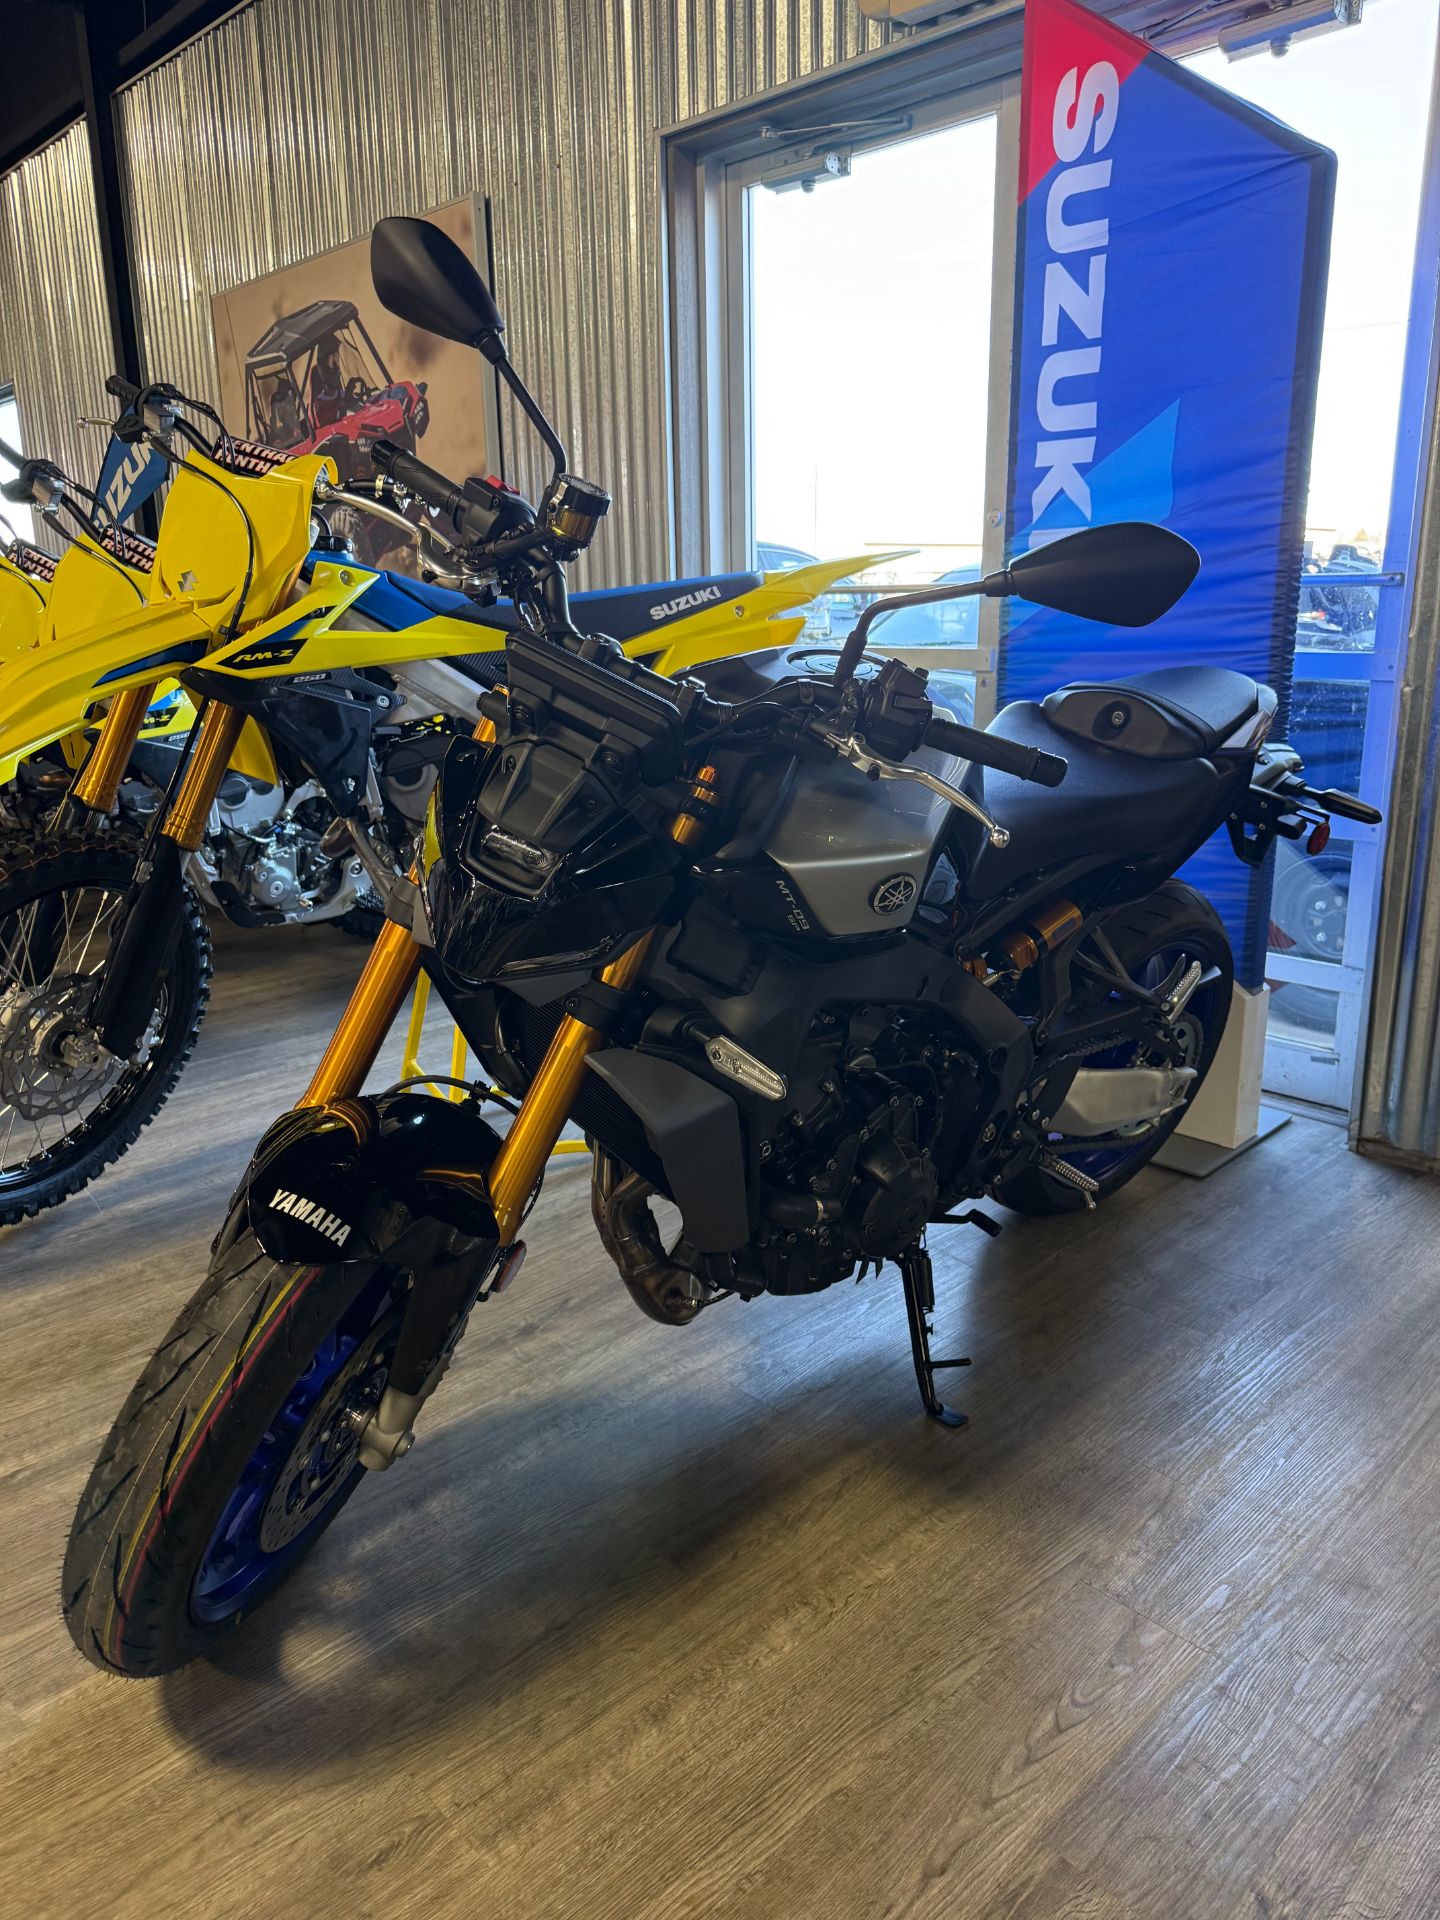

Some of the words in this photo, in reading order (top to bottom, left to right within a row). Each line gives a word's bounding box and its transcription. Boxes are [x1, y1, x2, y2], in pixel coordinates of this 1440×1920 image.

[1027, 61, 1120, 549] SUZUK
[649, 585, 722, 621] SUZUKI
[232, 648, 295, 664] RM-Z
[292, 672, 327, 685] 250
[775, 880, 810, 930] MT-09
[268, 1188, 352, 1248] YAMAHA
